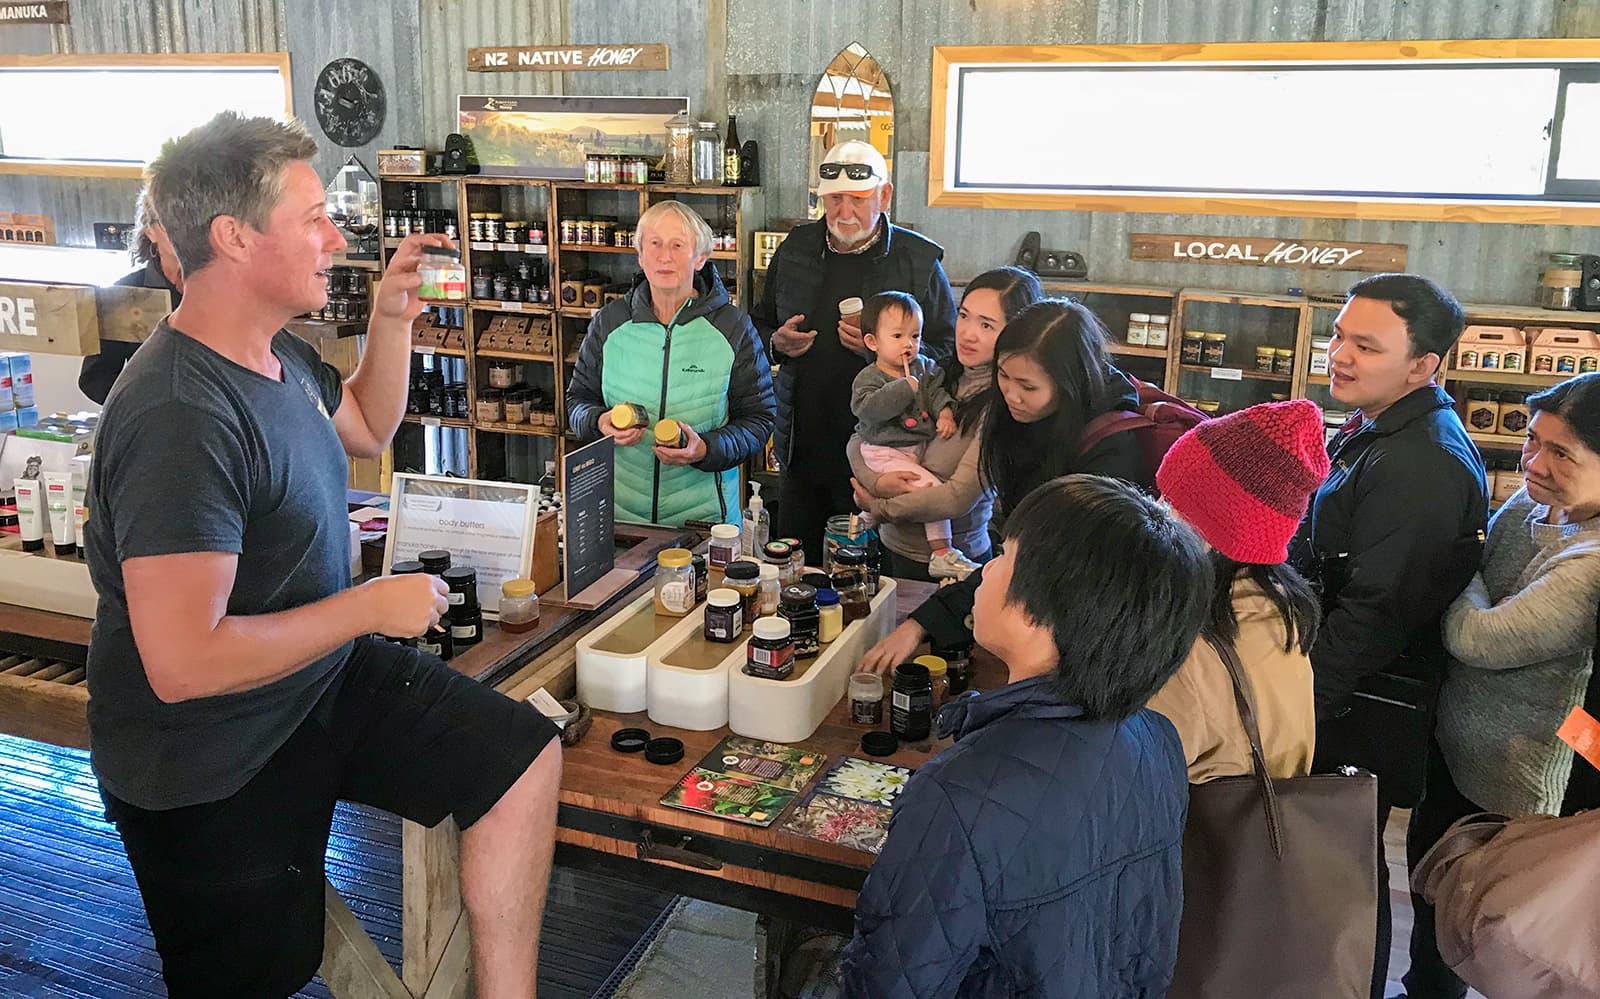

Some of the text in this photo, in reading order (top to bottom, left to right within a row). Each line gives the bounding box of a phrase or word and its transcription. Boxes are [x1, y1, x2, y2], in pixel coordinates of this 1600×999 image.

[485, 47, 643, 66] NZ NATIVE HONEY
[1173, 241, 1364, 266] LOCAL HONEY
[438, 518, 486, 530] body butters
